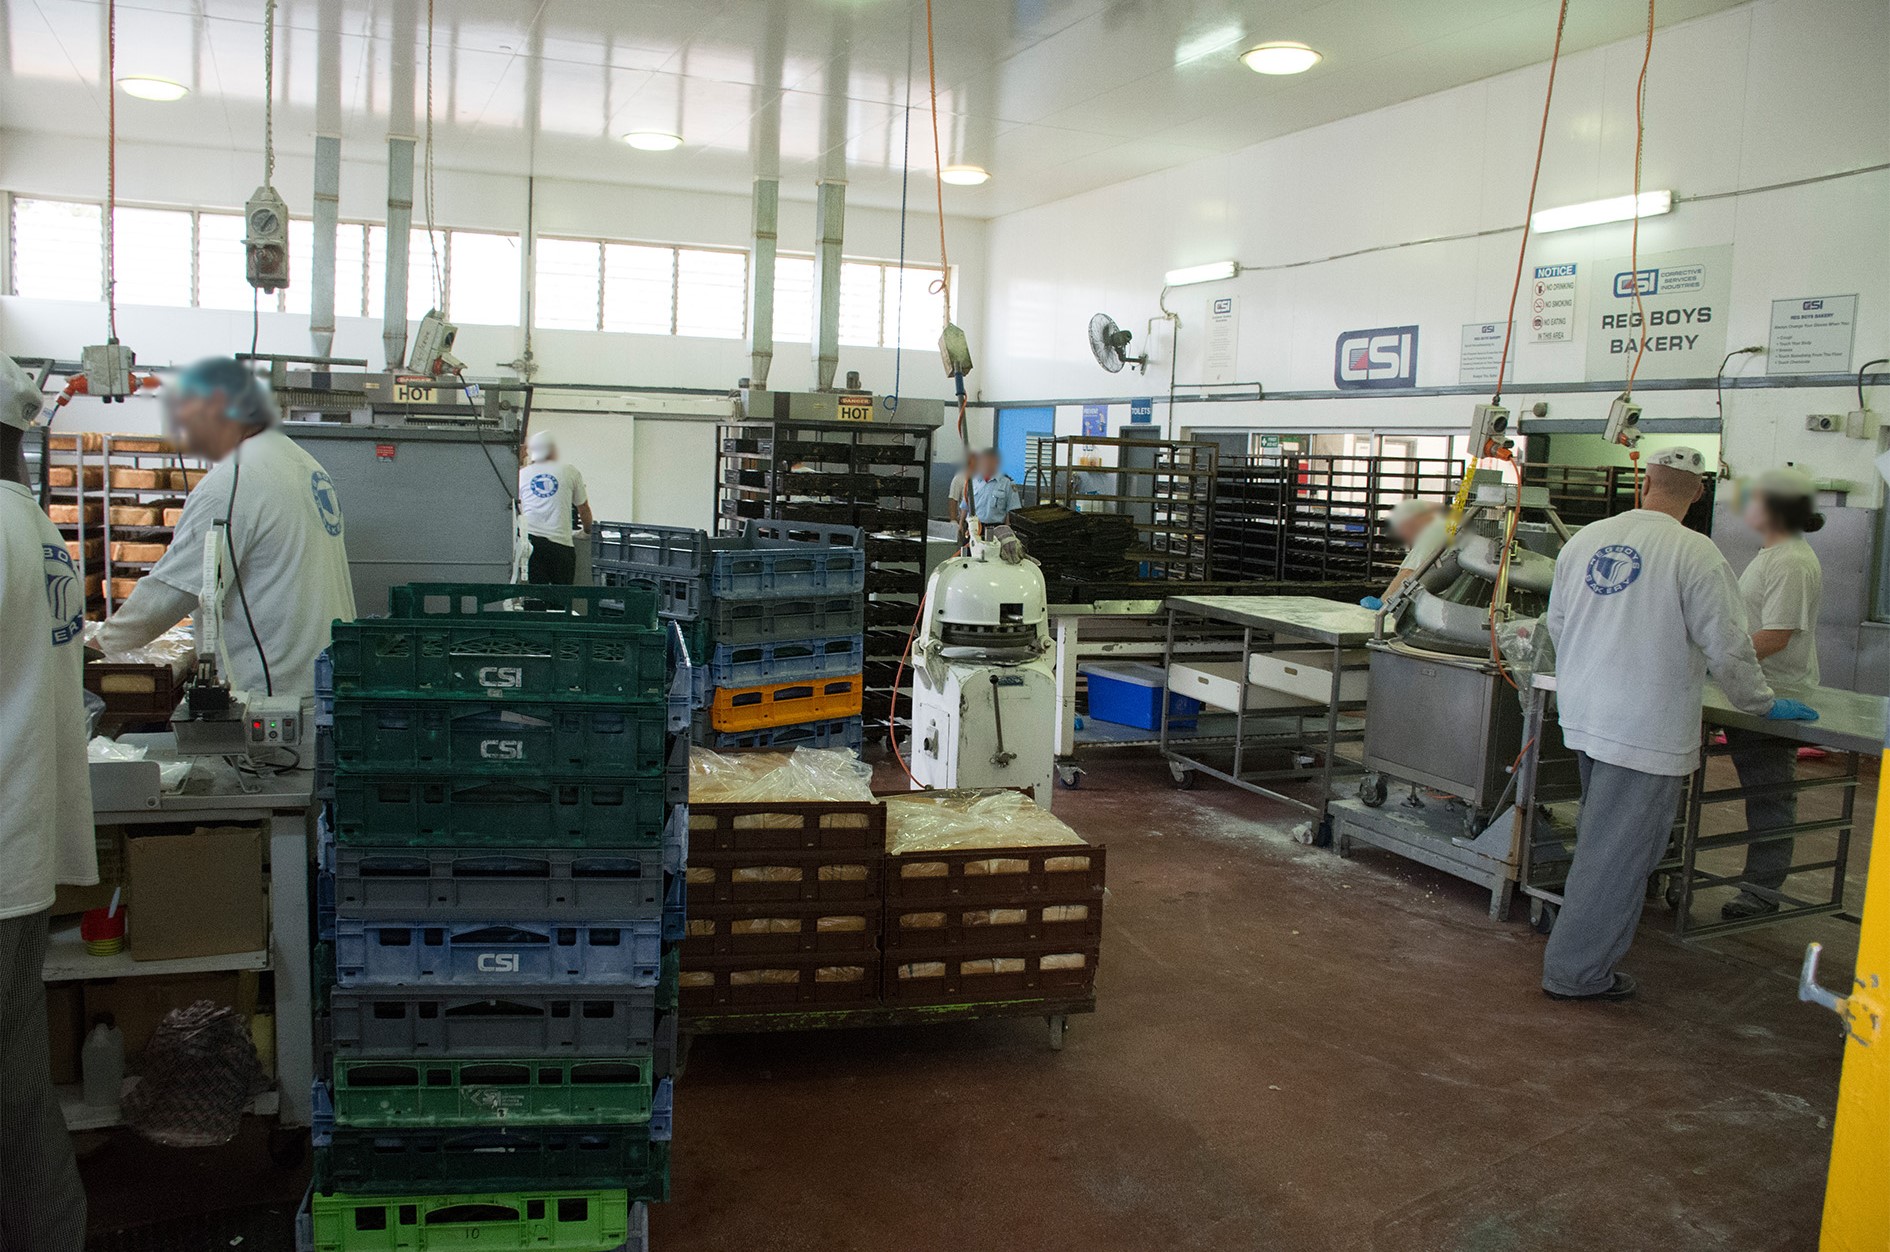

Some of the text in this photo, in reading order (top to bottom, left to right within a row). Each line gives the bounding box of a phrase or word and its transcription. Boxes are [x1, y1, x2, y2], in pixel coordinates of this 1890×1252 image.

[1537, 265, 1574, 278] NOTICE
[1660, 268, 1702, 278] CORRECTIVE
[1553, 282, 1574, 290] DRINKING
[1616, 271, 1656, 296] CSI
[1660, 282, 1701, 291] INDUSTRIES
[1664, 276, 1697, 284] SERVICES
[1802, 300, 1823, 310] CSI
[1550, 318, 1566, 326] EATING
[1602, 307, 1712, 329] REG BOYS
[1553, 332, 1564, 340] AREA
[1610, 334, 1699, 354] BAKERY
[1340, 333, 1412, 382] CSI
[400, 386, 431, 401] HOT
[841, 407, 869, 420] HOT
[1131, 407, 1151, 415] TOILETS
[479, 667, 522, 688] CSI
[480, 740, 523, 759] CSI
[477, 953, 519, 972] CSI
[465, 1227, 480, 1239] 10
